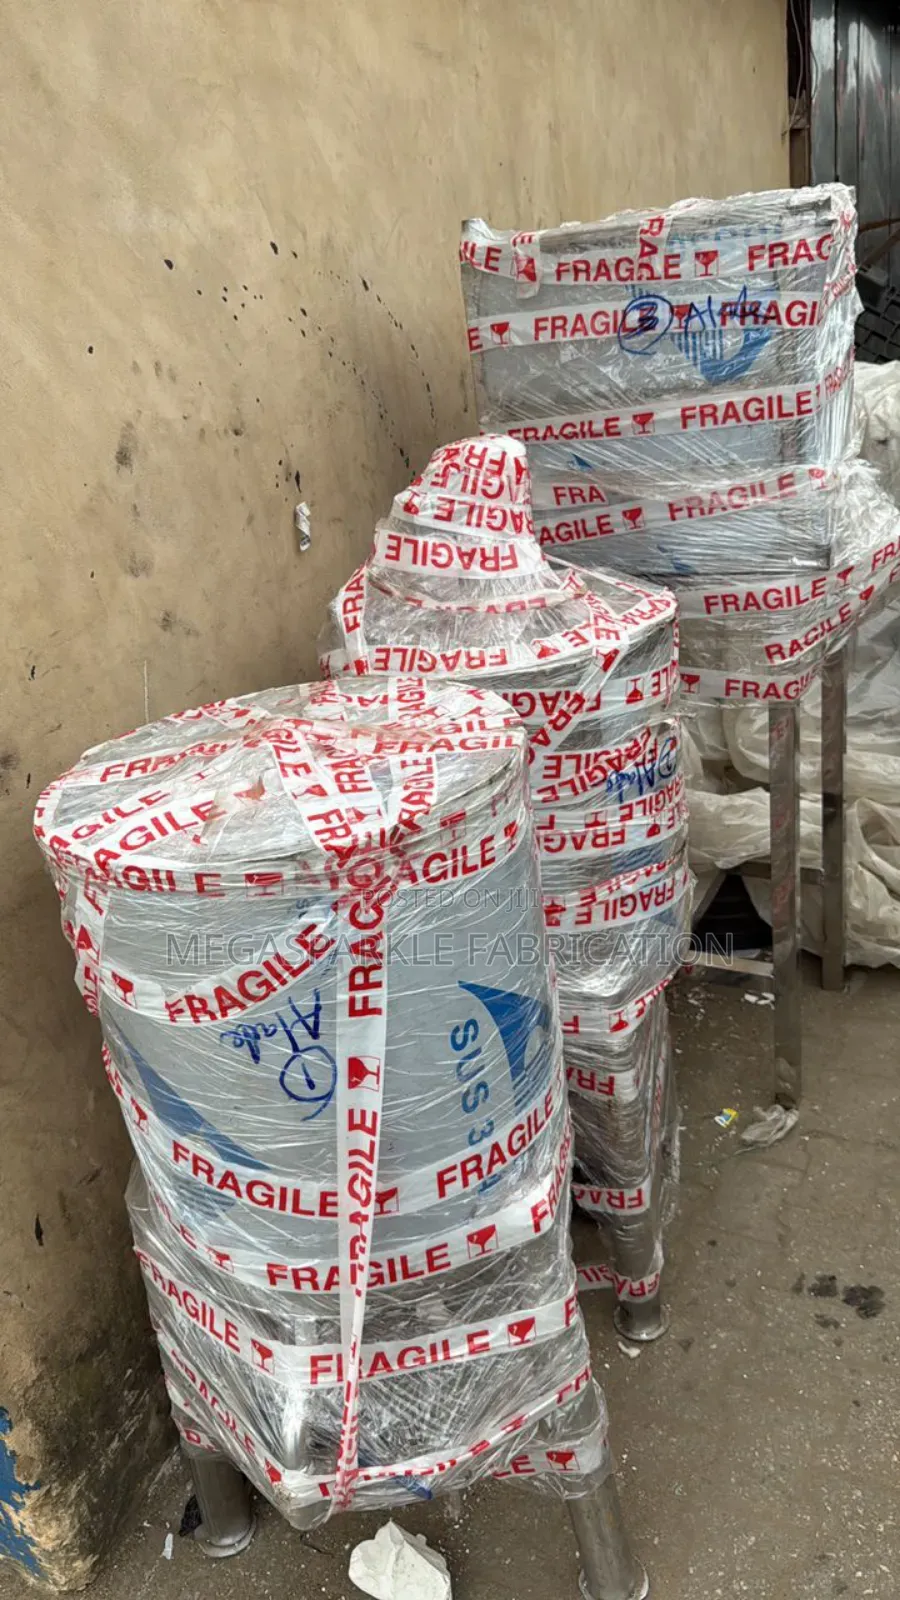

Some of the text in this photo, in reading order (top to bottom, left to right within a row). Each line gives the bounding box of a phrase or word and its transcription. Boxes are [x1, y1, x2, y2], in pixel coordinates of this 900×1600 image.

[680, 391, 812, 430] FRAGILE
[669, 473, 799, 521] FRAGILE
[385, 534, 518, 572] FRAGILE
[703, 576, 827, 615] FRAGILE
[373, 647, 508, 674] FRAGILE
[575, 881, 676, 925] FRAGILE
[165, 924, 335, 1024] FRAGILE
[450, 1018, 489, 1114] SUS
[437, 1089, 554, 1199] FRAGILE
[172, 1139, 338, 1218] FRAGILE
[136, 1250, 241, 1354] FRAGILE
